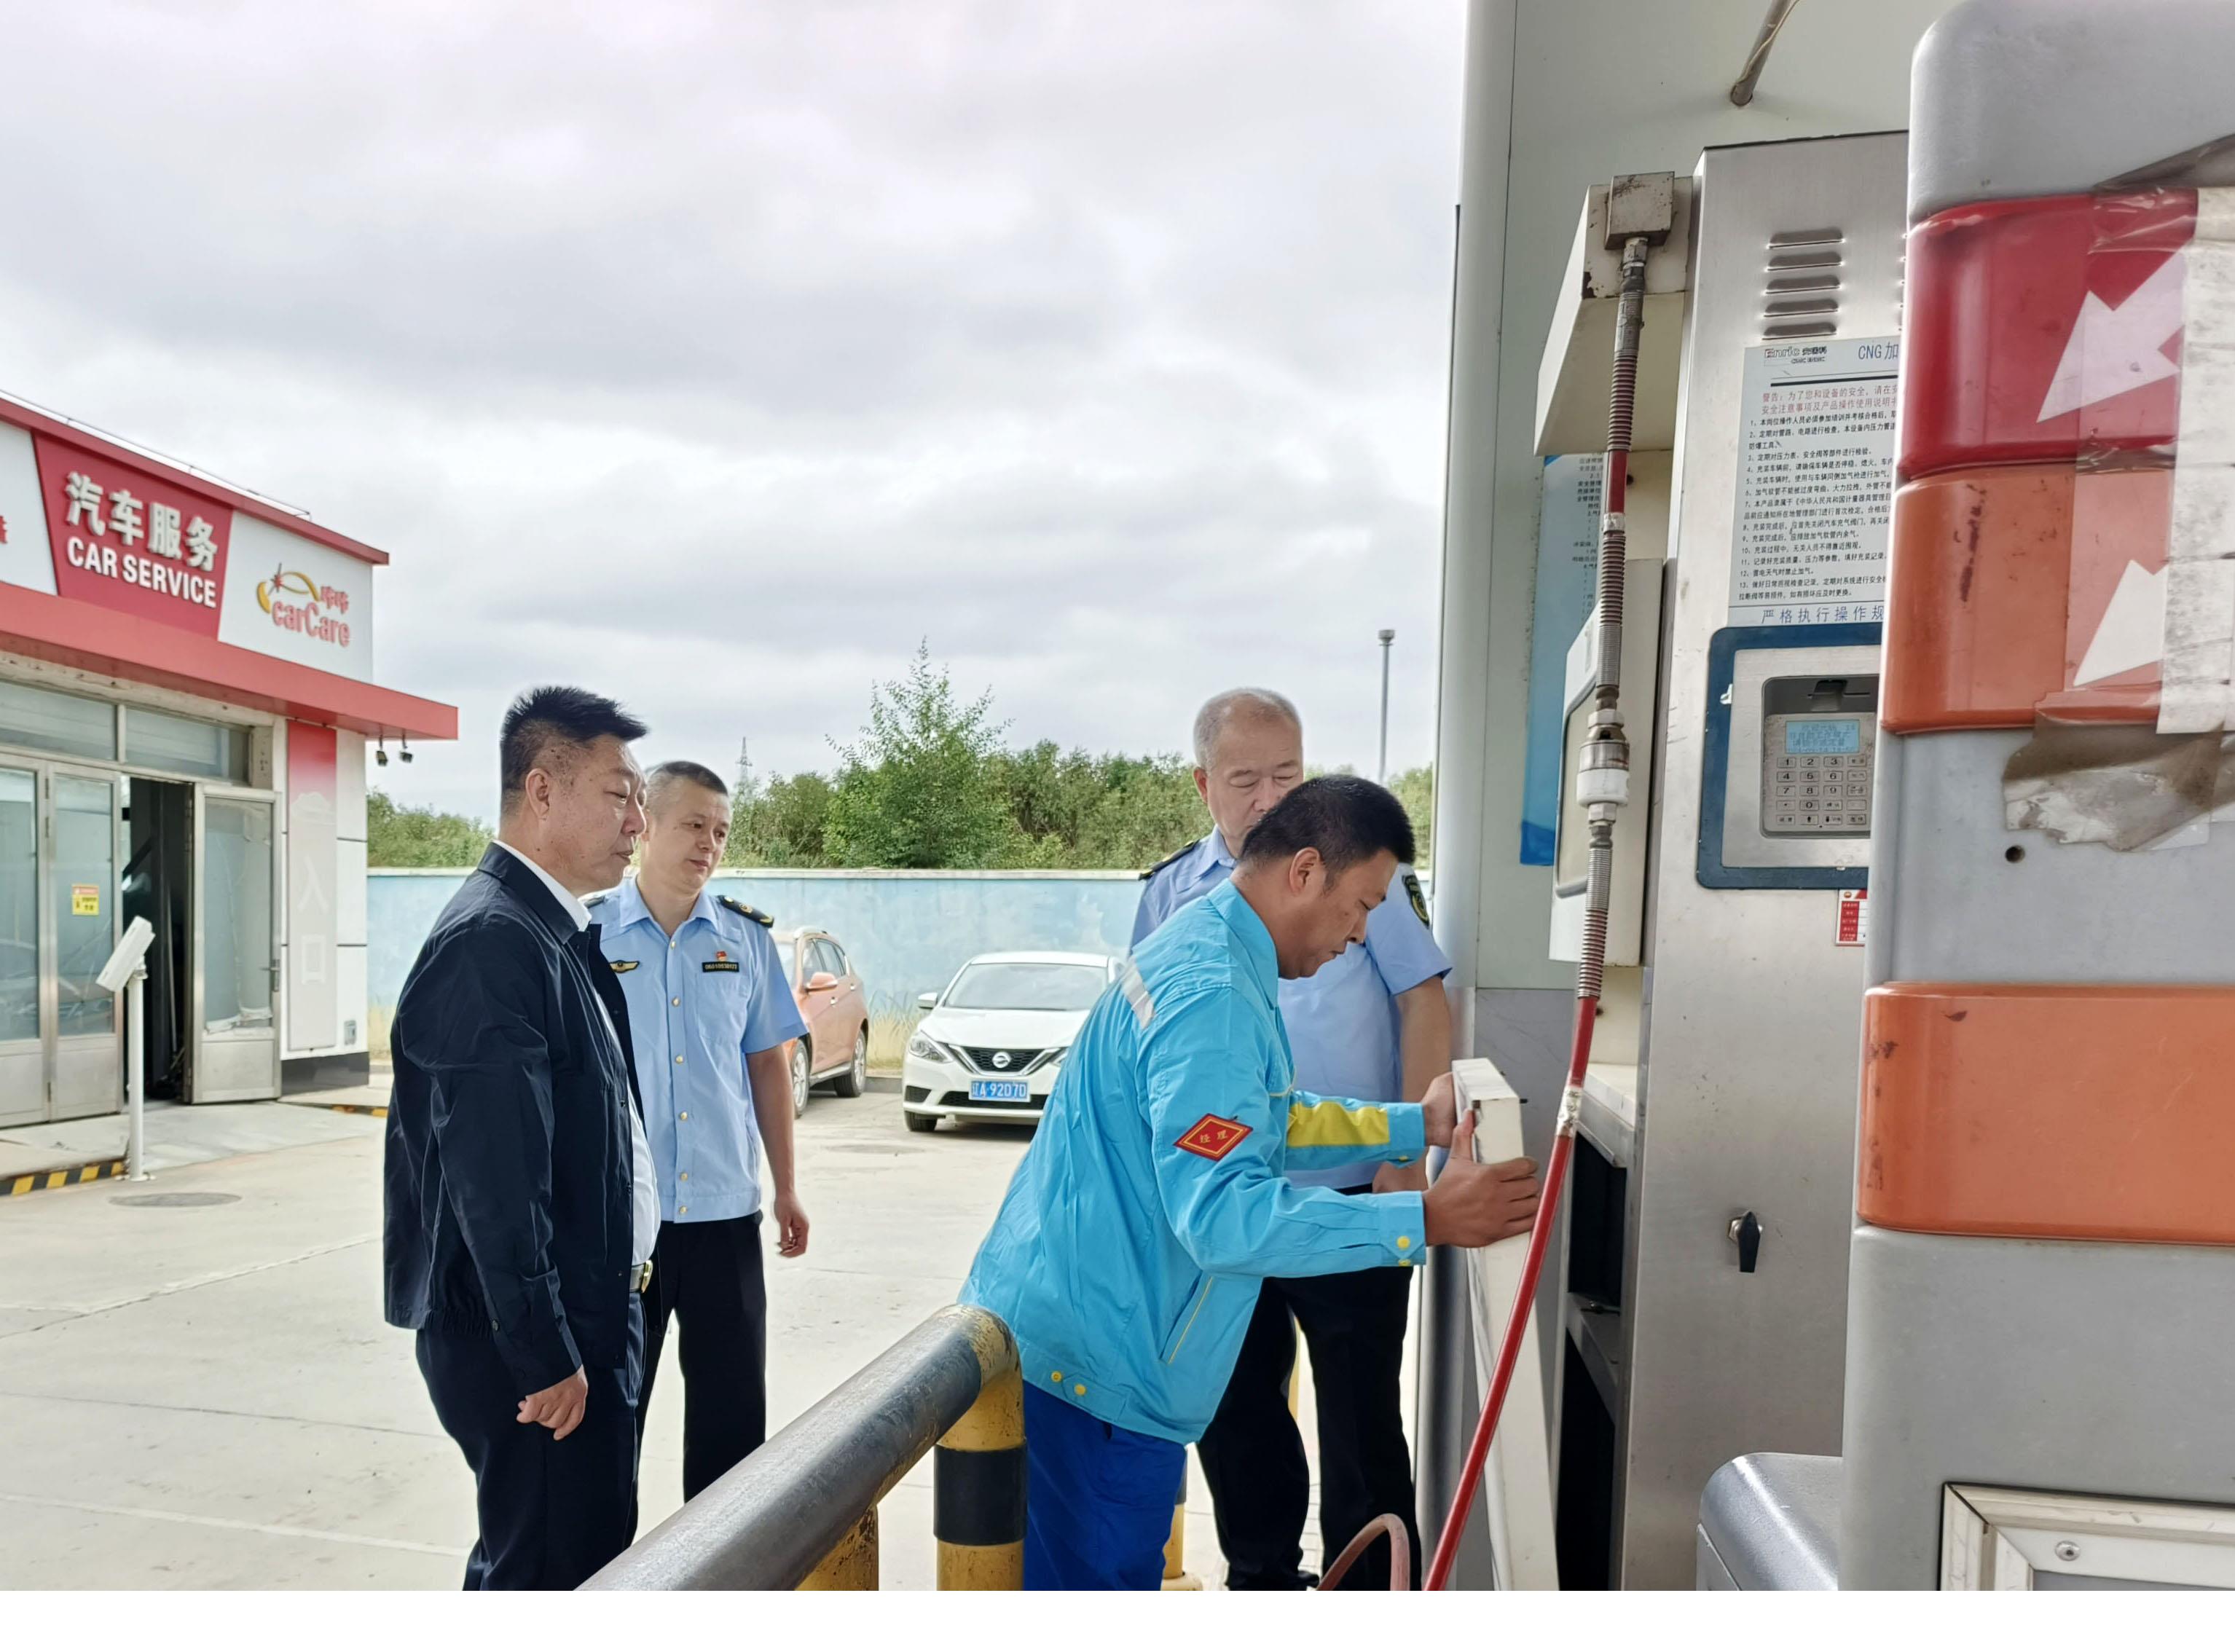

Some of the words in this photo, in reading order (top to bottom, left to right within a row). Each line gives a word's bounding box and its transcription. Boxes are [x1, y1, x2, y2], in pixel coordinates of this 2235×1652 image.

[1858, 345, 1882, 360] CNG
[65, 471, 218, 571] 汽车服务
[67, 537, 118, 578] CAR
[123, 558, 217, 608] SERVICE
[272, 601, 350, 648] carCare
[1761, 605, 1885, 624] 严格执行操作规
